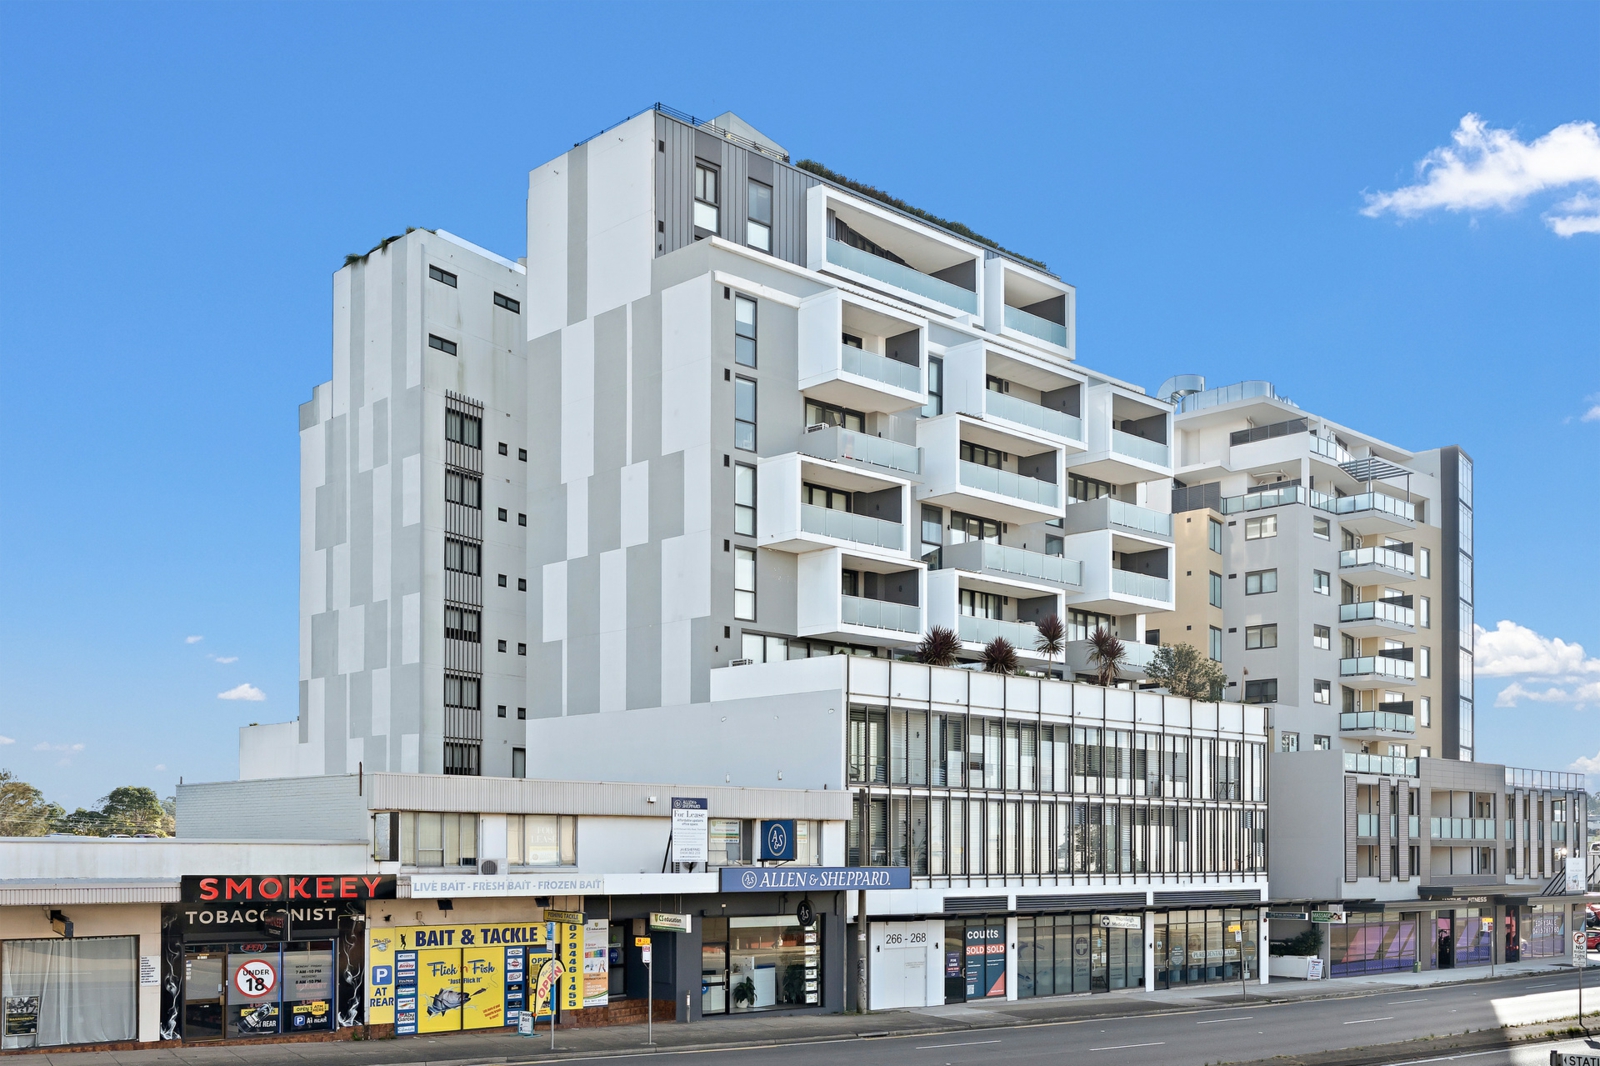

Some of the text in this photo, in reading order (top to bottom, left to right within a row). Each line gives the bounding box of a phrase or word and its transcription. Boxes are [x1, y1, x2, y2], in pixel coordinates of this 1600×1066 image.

[414, 882, 437, 892] LIVE
[440, 881, 466, 891] BAIT
[473, 882, 505, 891] FRESH
[507, 881, 532, 890] BAIT
[538, 881, 577, 890] FROZEN
[579, 880, 601, 889] BAIT
[760, 872, 807, 887] ALLEN
[809, 874, 818, 885] &
[200, 877, 382, 900] SMOKEEY
[185, 908, 336, 924] TOBACCNIST
[415, 927, 538, 947] BAIT & TACKLE
[886, 934, 902, 944] 266
[911, 933, 926, 943] 268
[967, 929, 999, 939] coutts
[966, 946, 984, 955] SOLD
[987, 945, 1004, 953] SOLD
[427, 961, 458, 977] Flick
[468, 959, 495, 974] Fish
[376, 968, 388, 982] P
[246, 978, 265, 991] 18
[538, 966, 562, 998] OPEN
[375, 987, 387, 996] AT
[370, 997, 394, 1007] REAR
